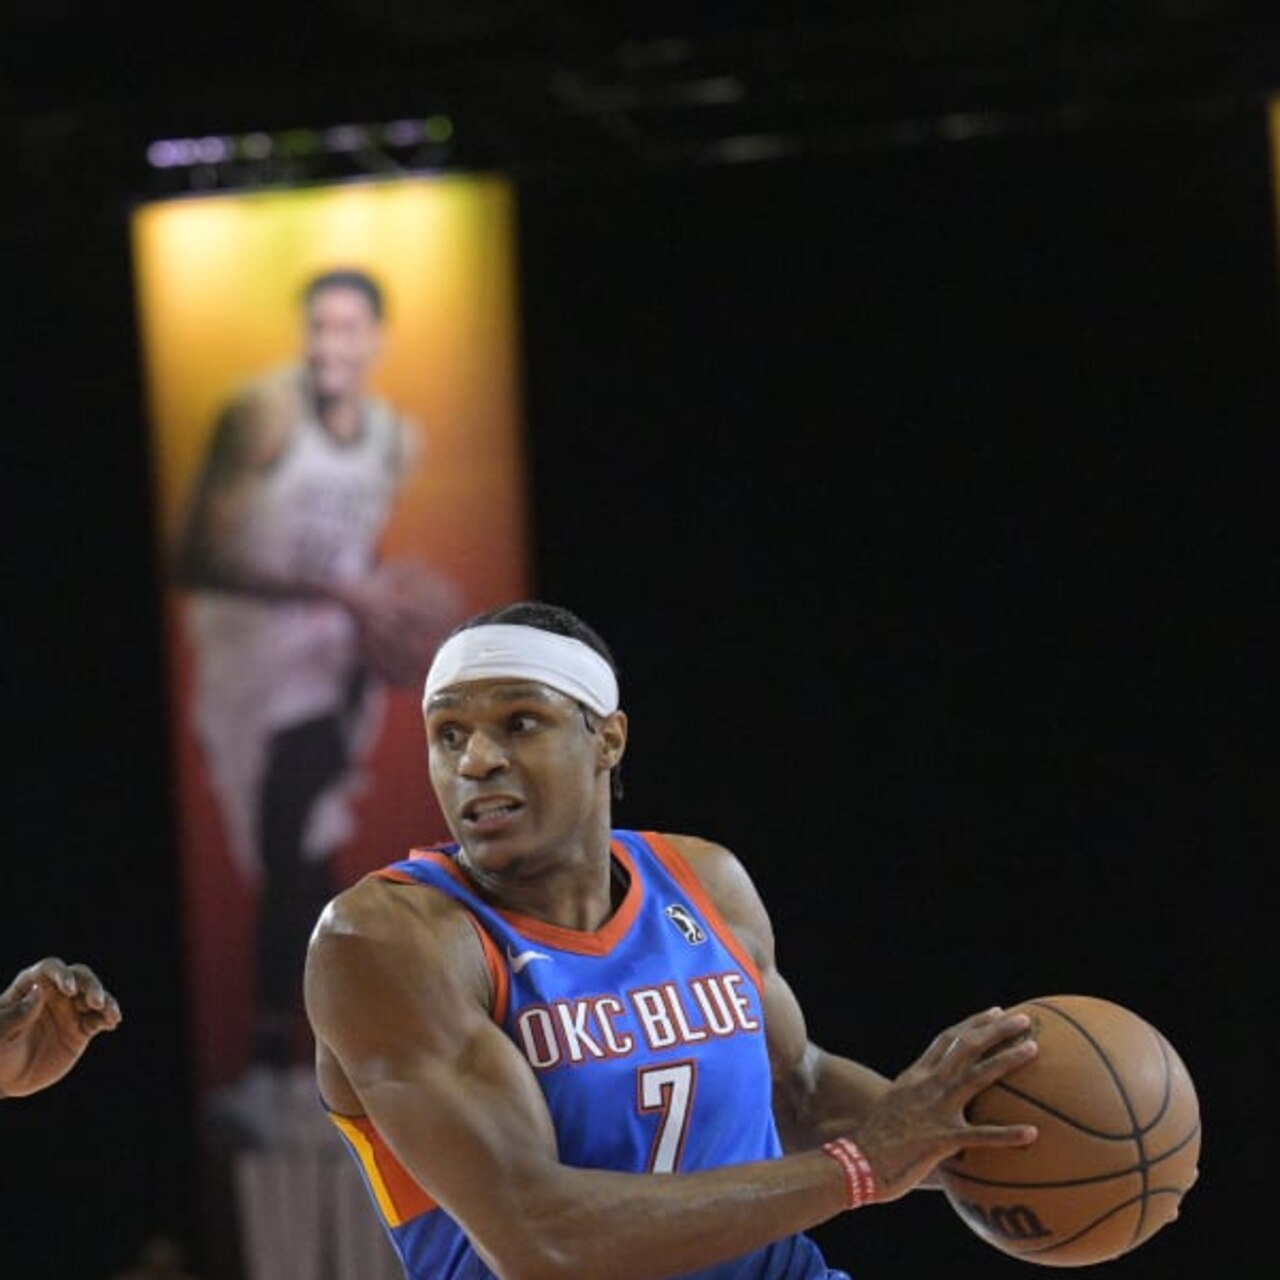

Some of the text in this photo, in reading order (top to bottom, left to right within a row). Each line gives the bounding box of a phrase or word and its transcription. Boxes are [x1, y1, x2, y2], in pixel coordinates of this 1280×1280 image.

[518, 972, 760, 1071] OKC BLUE
[637, 1057, 697, 1175] 7
